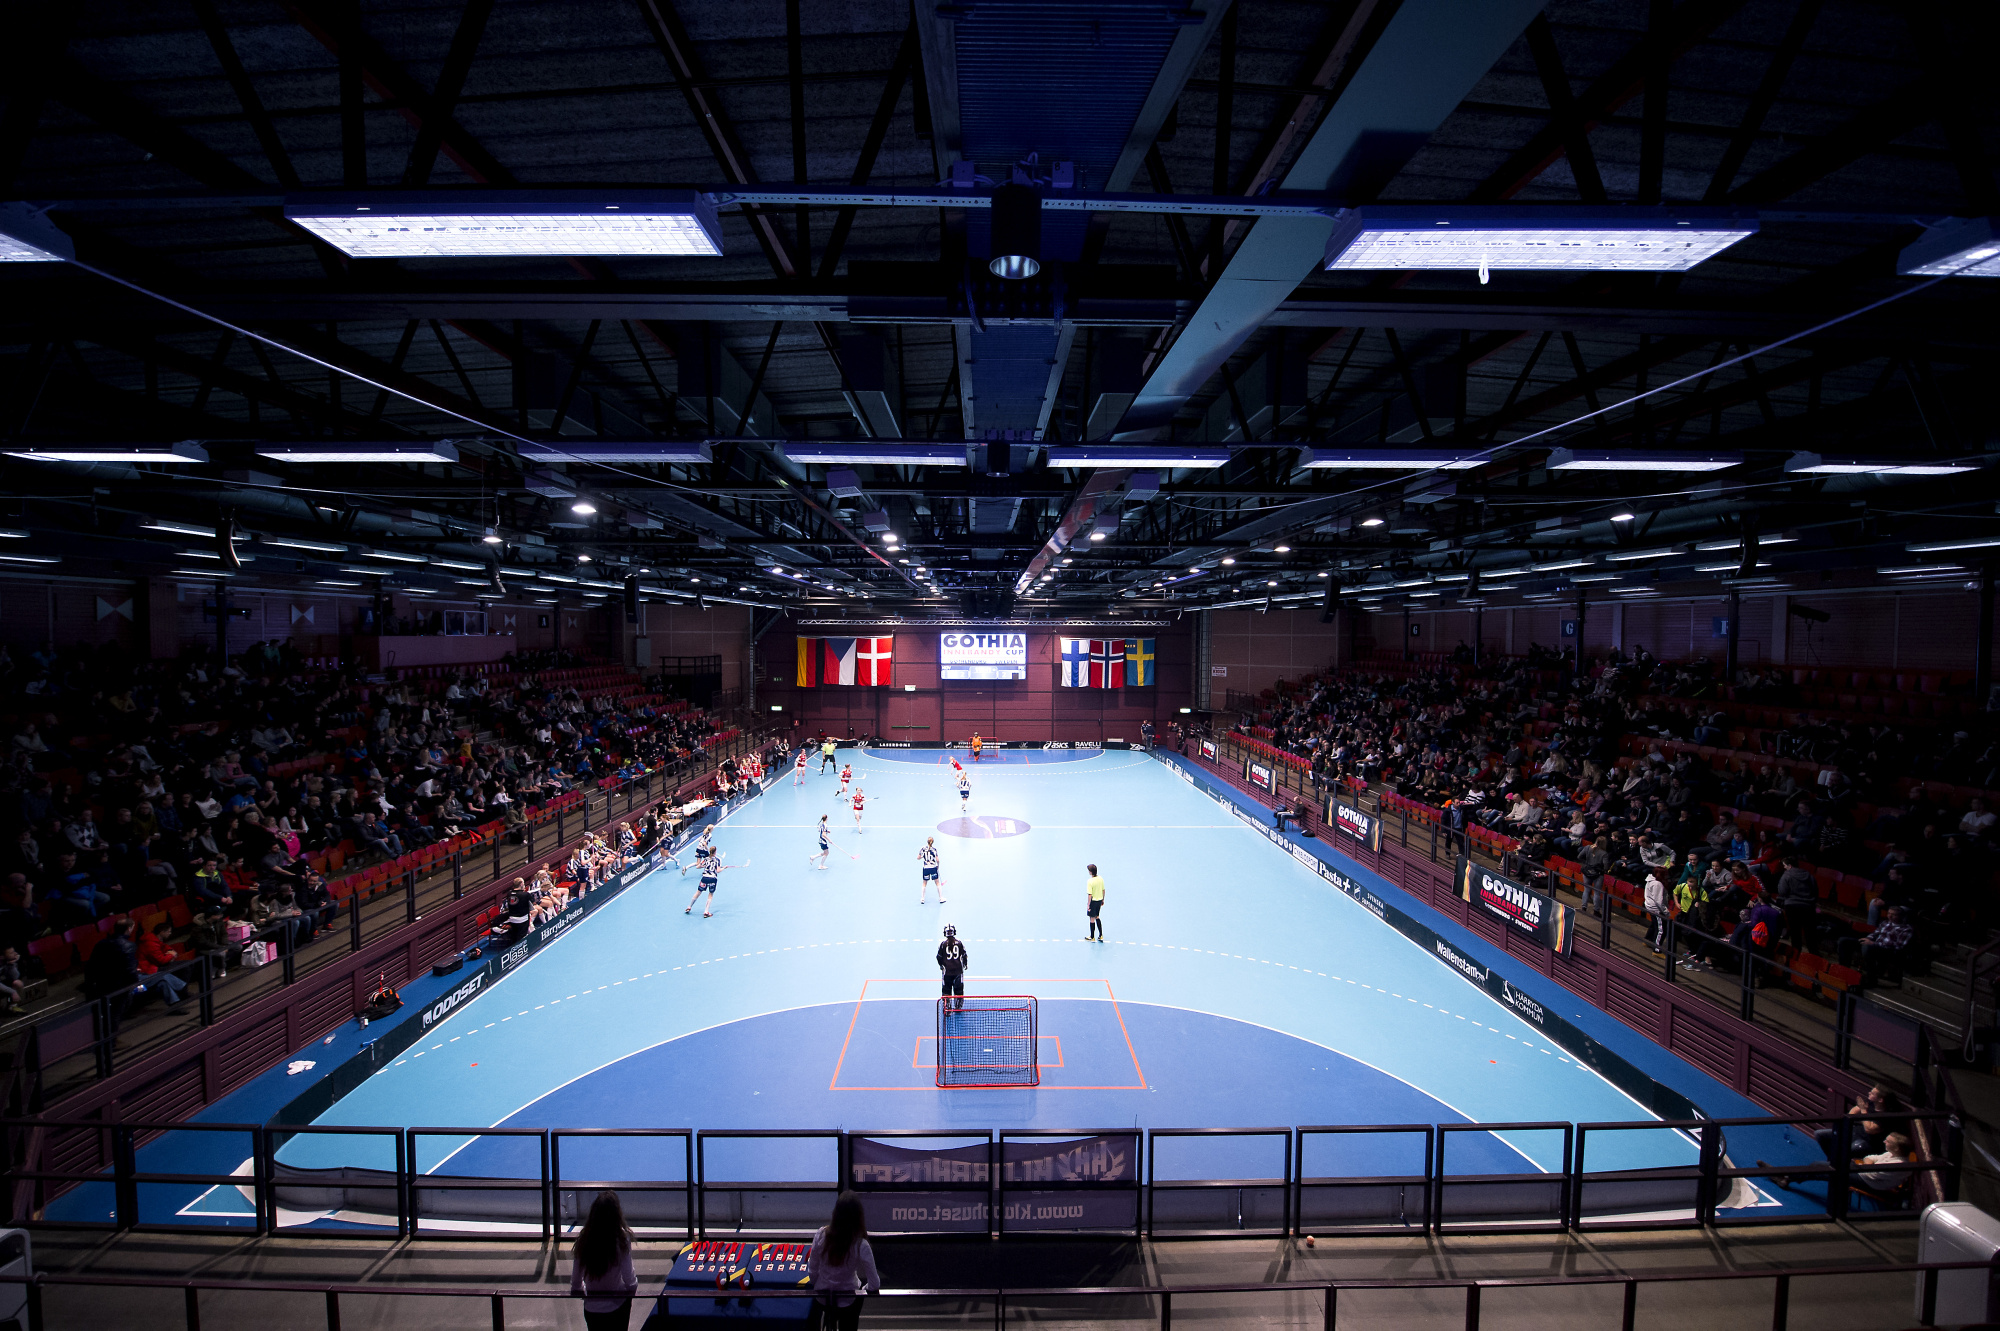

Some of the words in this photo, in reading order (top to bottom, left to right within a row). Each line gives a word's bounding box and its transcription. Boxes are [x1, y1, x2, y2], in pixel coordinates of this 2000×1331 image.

[366, 610, 374, 623] A
[1565, 622, 1574, 635] G
[943, 634, 1023, 648] GOTHIA
[1252, 764, 1270, 779] GOTHIA
[1338, 804, 1369, 831] GOTHIA
[1480, 888, 1522, 916] INNEBANDY
[1524, 911, 1540, 925] CUP
[501, 943, 529, 969] Plast
[1436, 939, 1479, 979] Wallenstam
[433, 971, 485, 1021] ODDSET
[1515, 990, 1544, 1016] HÄRRYDA
[1515, 999, 1544, 1024] KOMMUN
